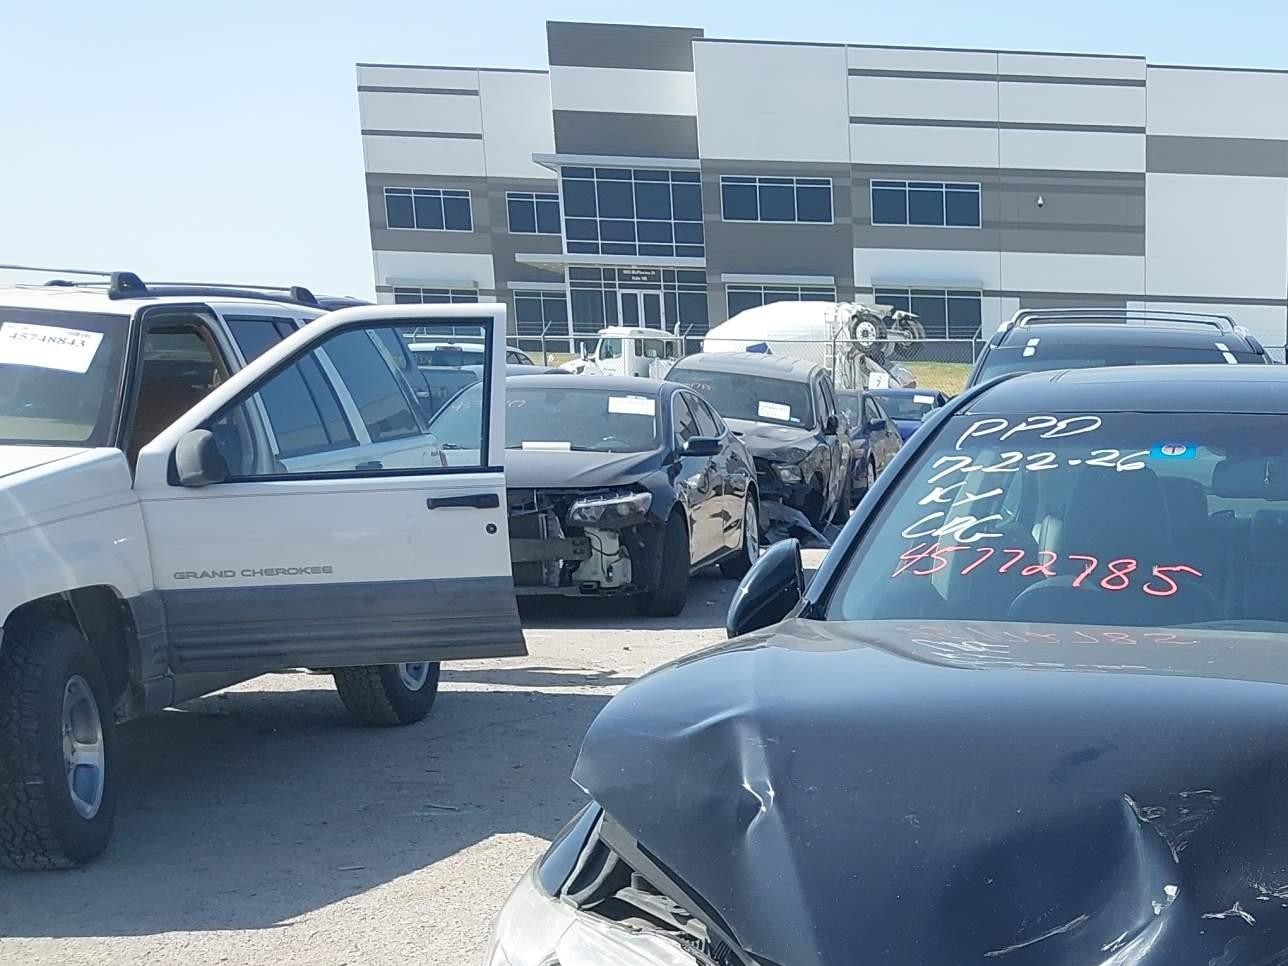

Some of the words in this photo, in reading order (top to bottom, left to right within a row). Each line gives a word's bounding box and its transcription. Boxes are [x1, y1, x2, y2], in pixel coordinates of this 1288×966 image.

[955, 416, 1102, 450] PPD
[173, 570, 236, 580] GRAND
[241, 565, 334, 577] CHEROKEE
[892, 543, 1203, 596] 45772785
